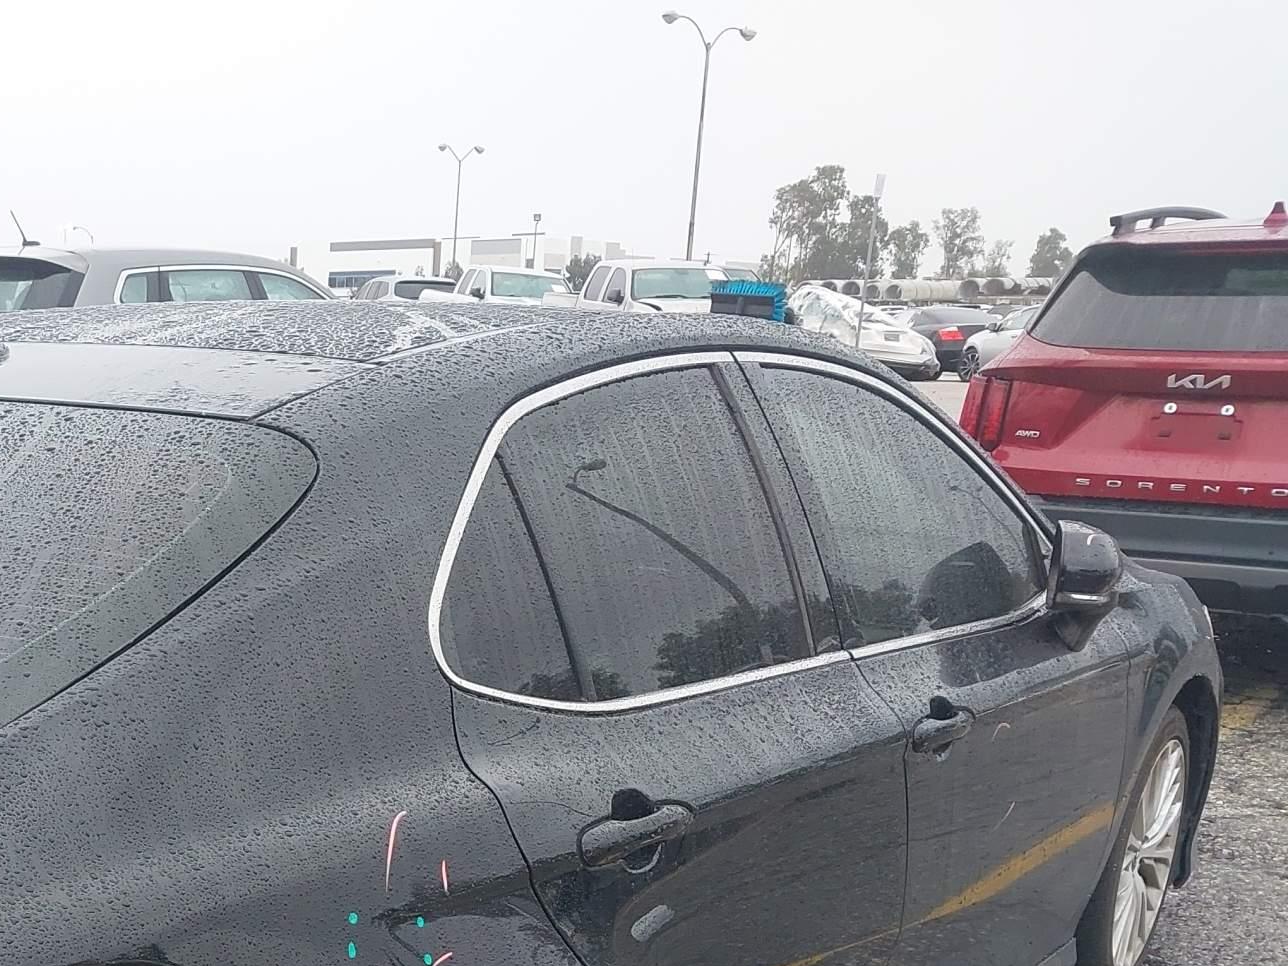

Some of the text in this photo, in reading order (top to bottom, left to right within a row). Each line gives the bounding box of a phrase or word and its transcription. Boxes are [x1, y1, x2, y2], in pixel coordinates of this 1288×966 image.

[1166, 373, 1232, 390] KIA
[1015, 429, 1041, 439] AWD
[1075, 477, 1288, 497] SORENTO
